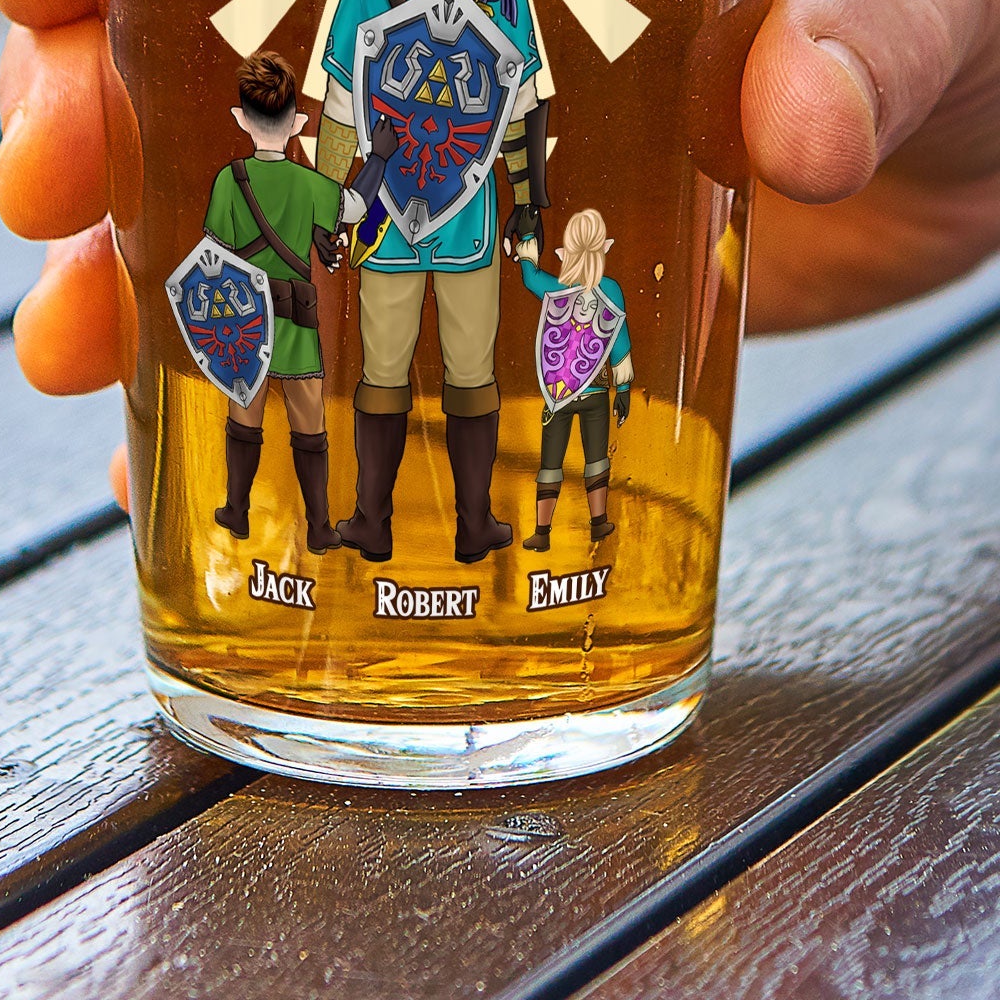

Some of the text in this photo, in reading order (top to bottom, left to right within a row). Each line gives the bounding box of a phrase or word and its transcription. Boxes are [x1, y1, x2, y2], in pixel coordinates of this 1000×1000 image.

[250, 561, 316, 609] JACK
[374, 579, 479, 618] ROBERT
[527, 566, 611, 611] EMILY
